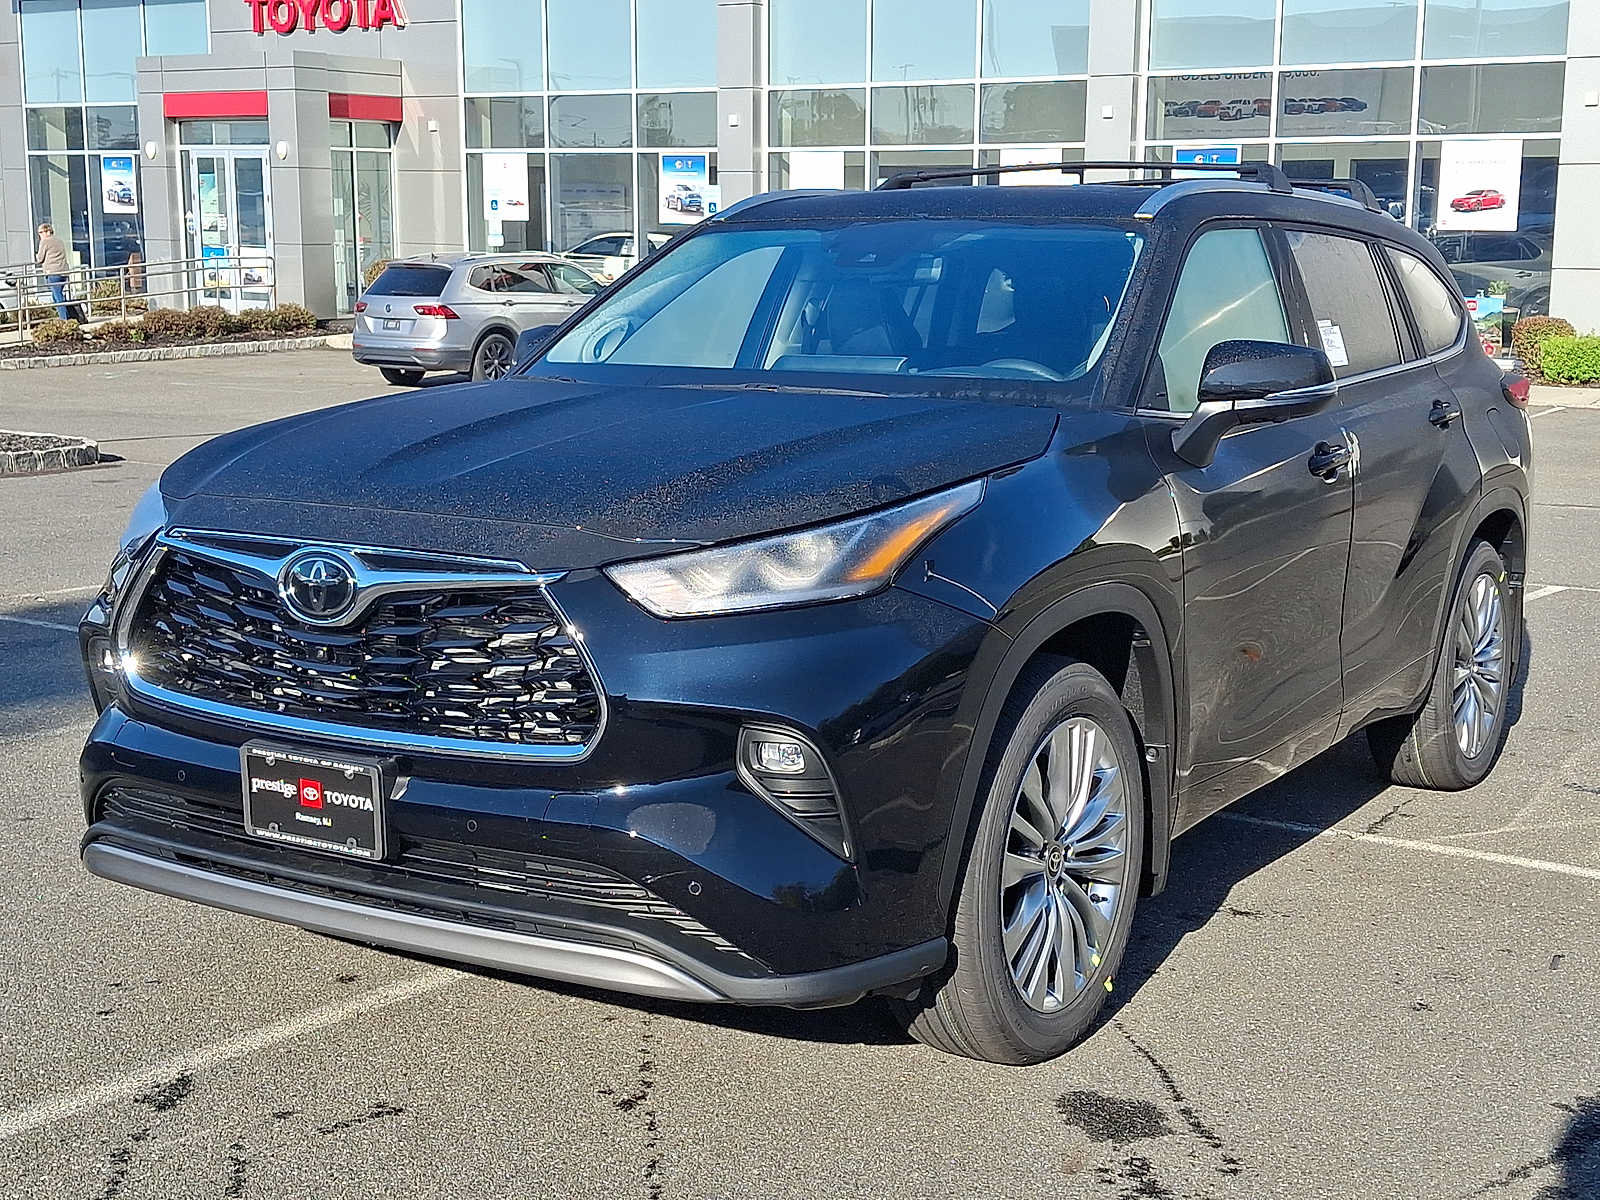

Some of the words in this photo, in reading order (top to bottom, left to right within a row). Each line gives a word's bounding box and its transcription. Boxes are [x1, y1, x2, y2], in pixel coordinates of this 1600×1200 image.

[244, 0, 408, 35] TOYOTA
[251, 777, 297, 799] prestige
[324, 790, 374, 812] TOYOTA
